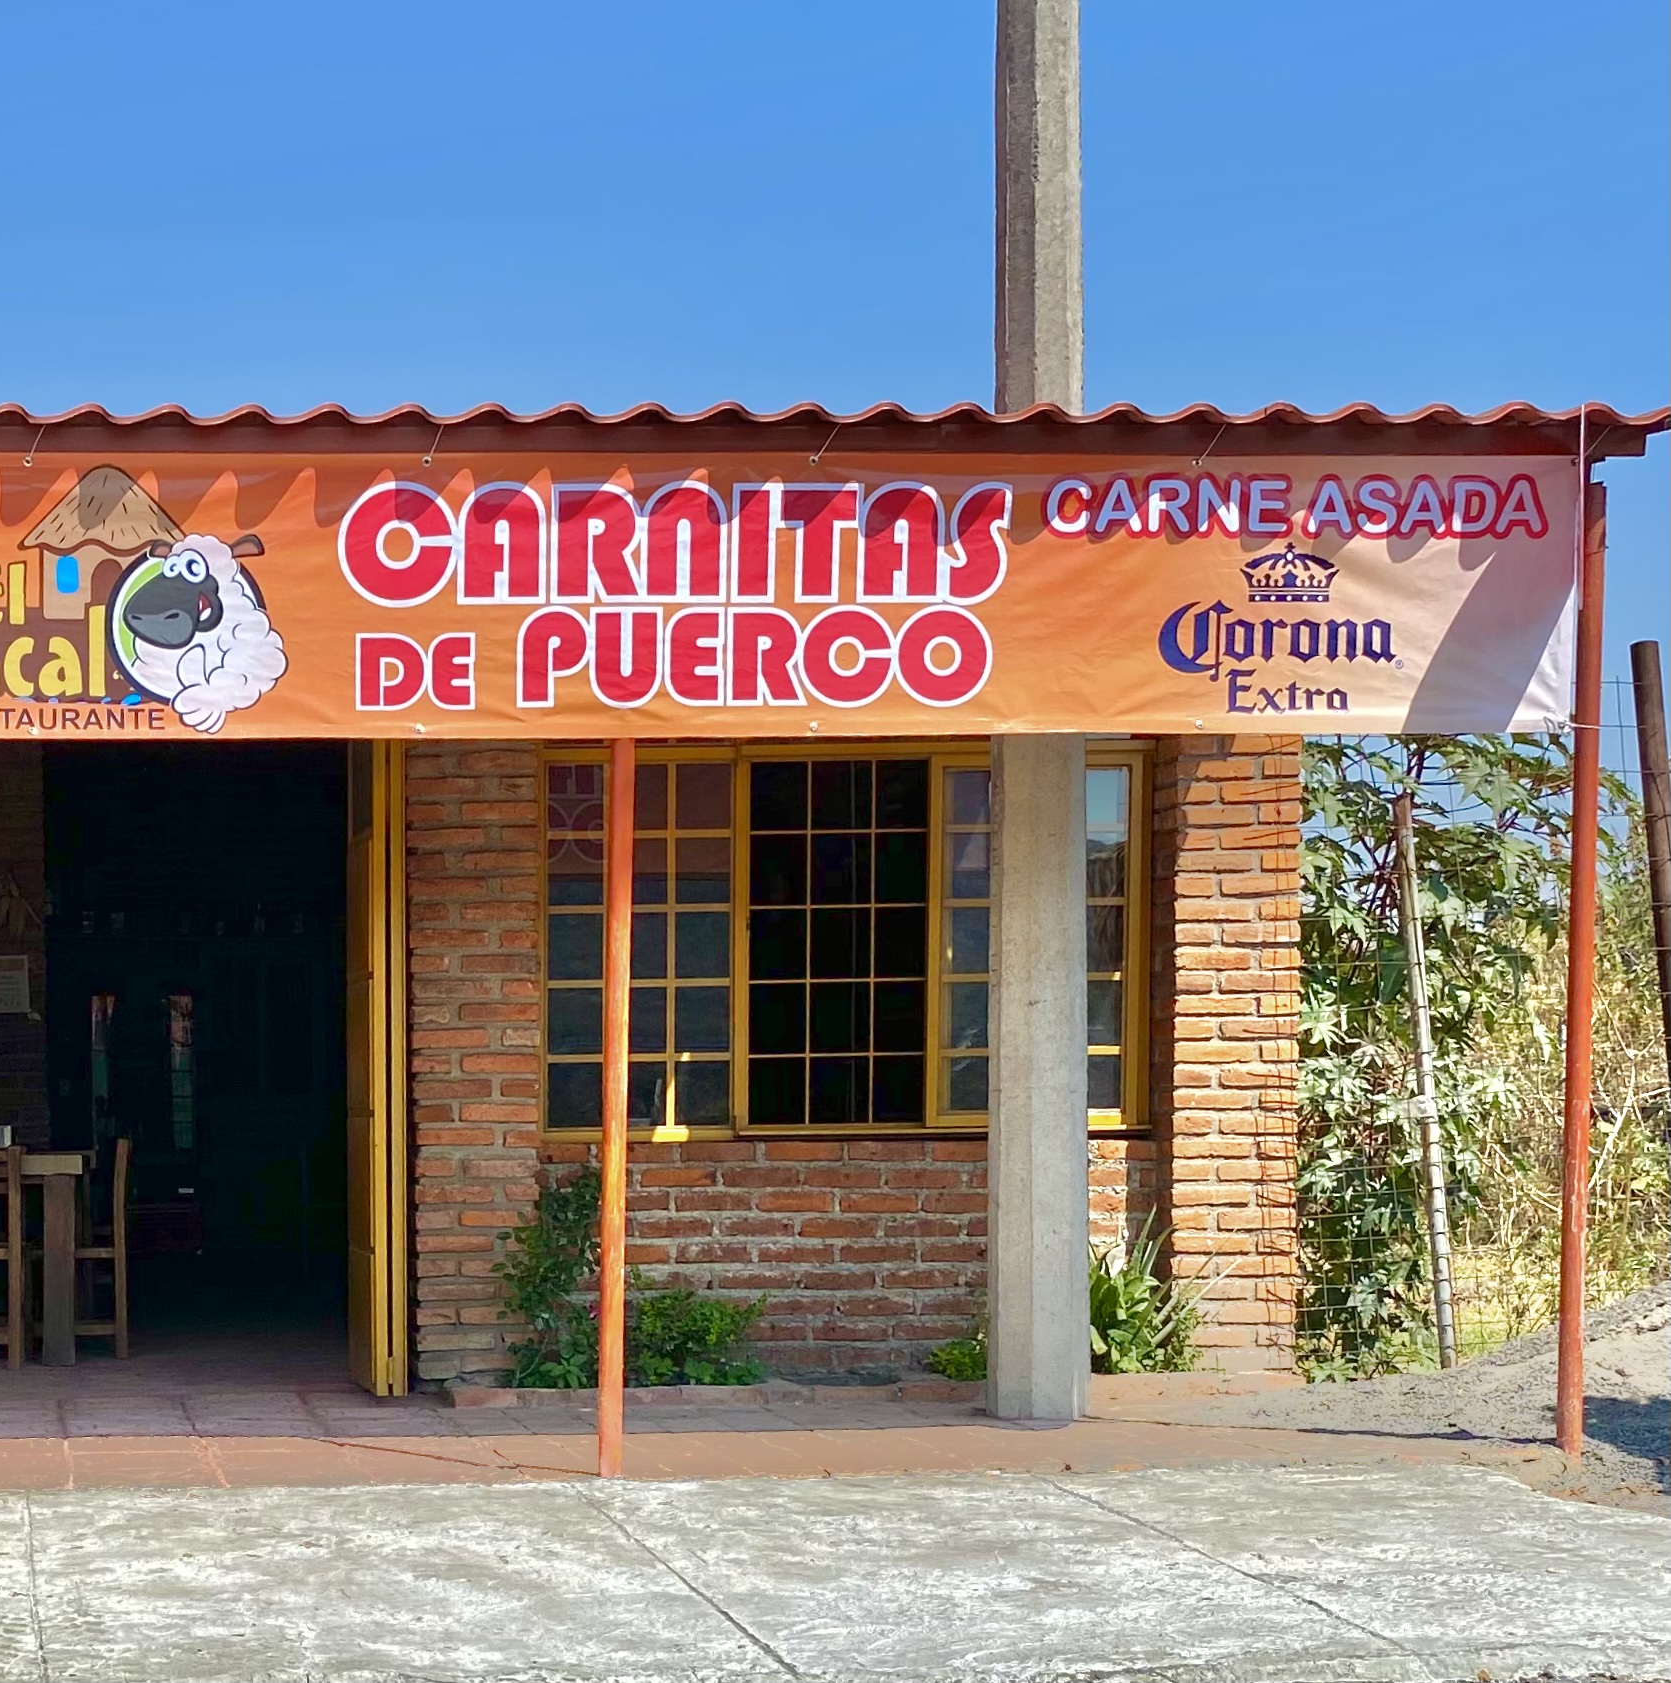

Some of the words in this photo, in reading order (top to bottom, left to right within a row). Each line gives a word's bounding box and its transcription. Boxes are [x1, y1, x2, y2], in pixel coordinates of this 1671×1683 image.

[338, 480, 1014, 608] CARNITAS
[1043, 474, 1292, 539] CARNE
[1303, 474, 1547, 539] ASADA
[355, 632, 476, 711] DE
[517, 604, 993, 709] PUERCO
[1158, 599, 1398, 682] Corona
[1224, 668, 1350, 716] Extra
